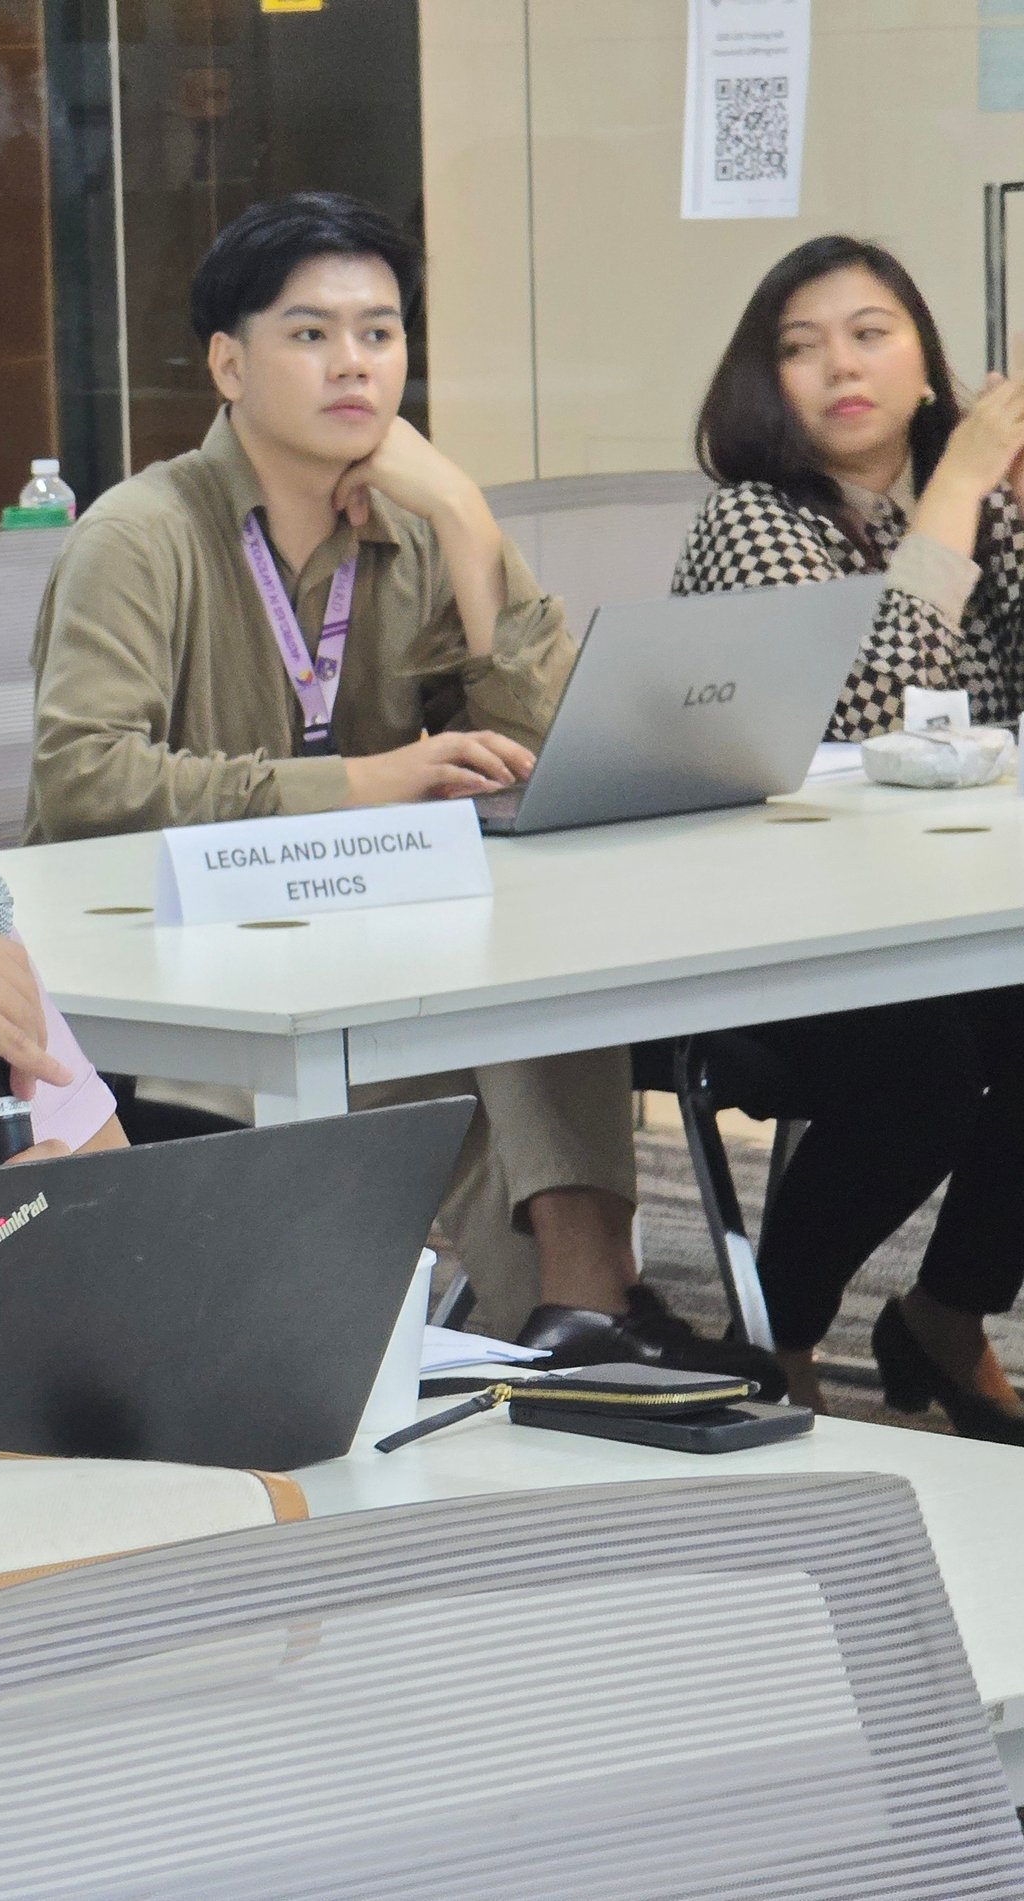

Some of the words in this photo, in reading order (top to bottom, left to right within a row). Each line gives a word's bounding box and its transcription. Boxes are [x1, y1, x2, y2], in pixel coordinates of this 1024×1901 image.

[204, 847, 276, 871] LEGAL
[279, 840, 327, 864] AND
[332, 831, 433, 859] JUDICIAL
[286, 875, 367, 901] ETHICS
